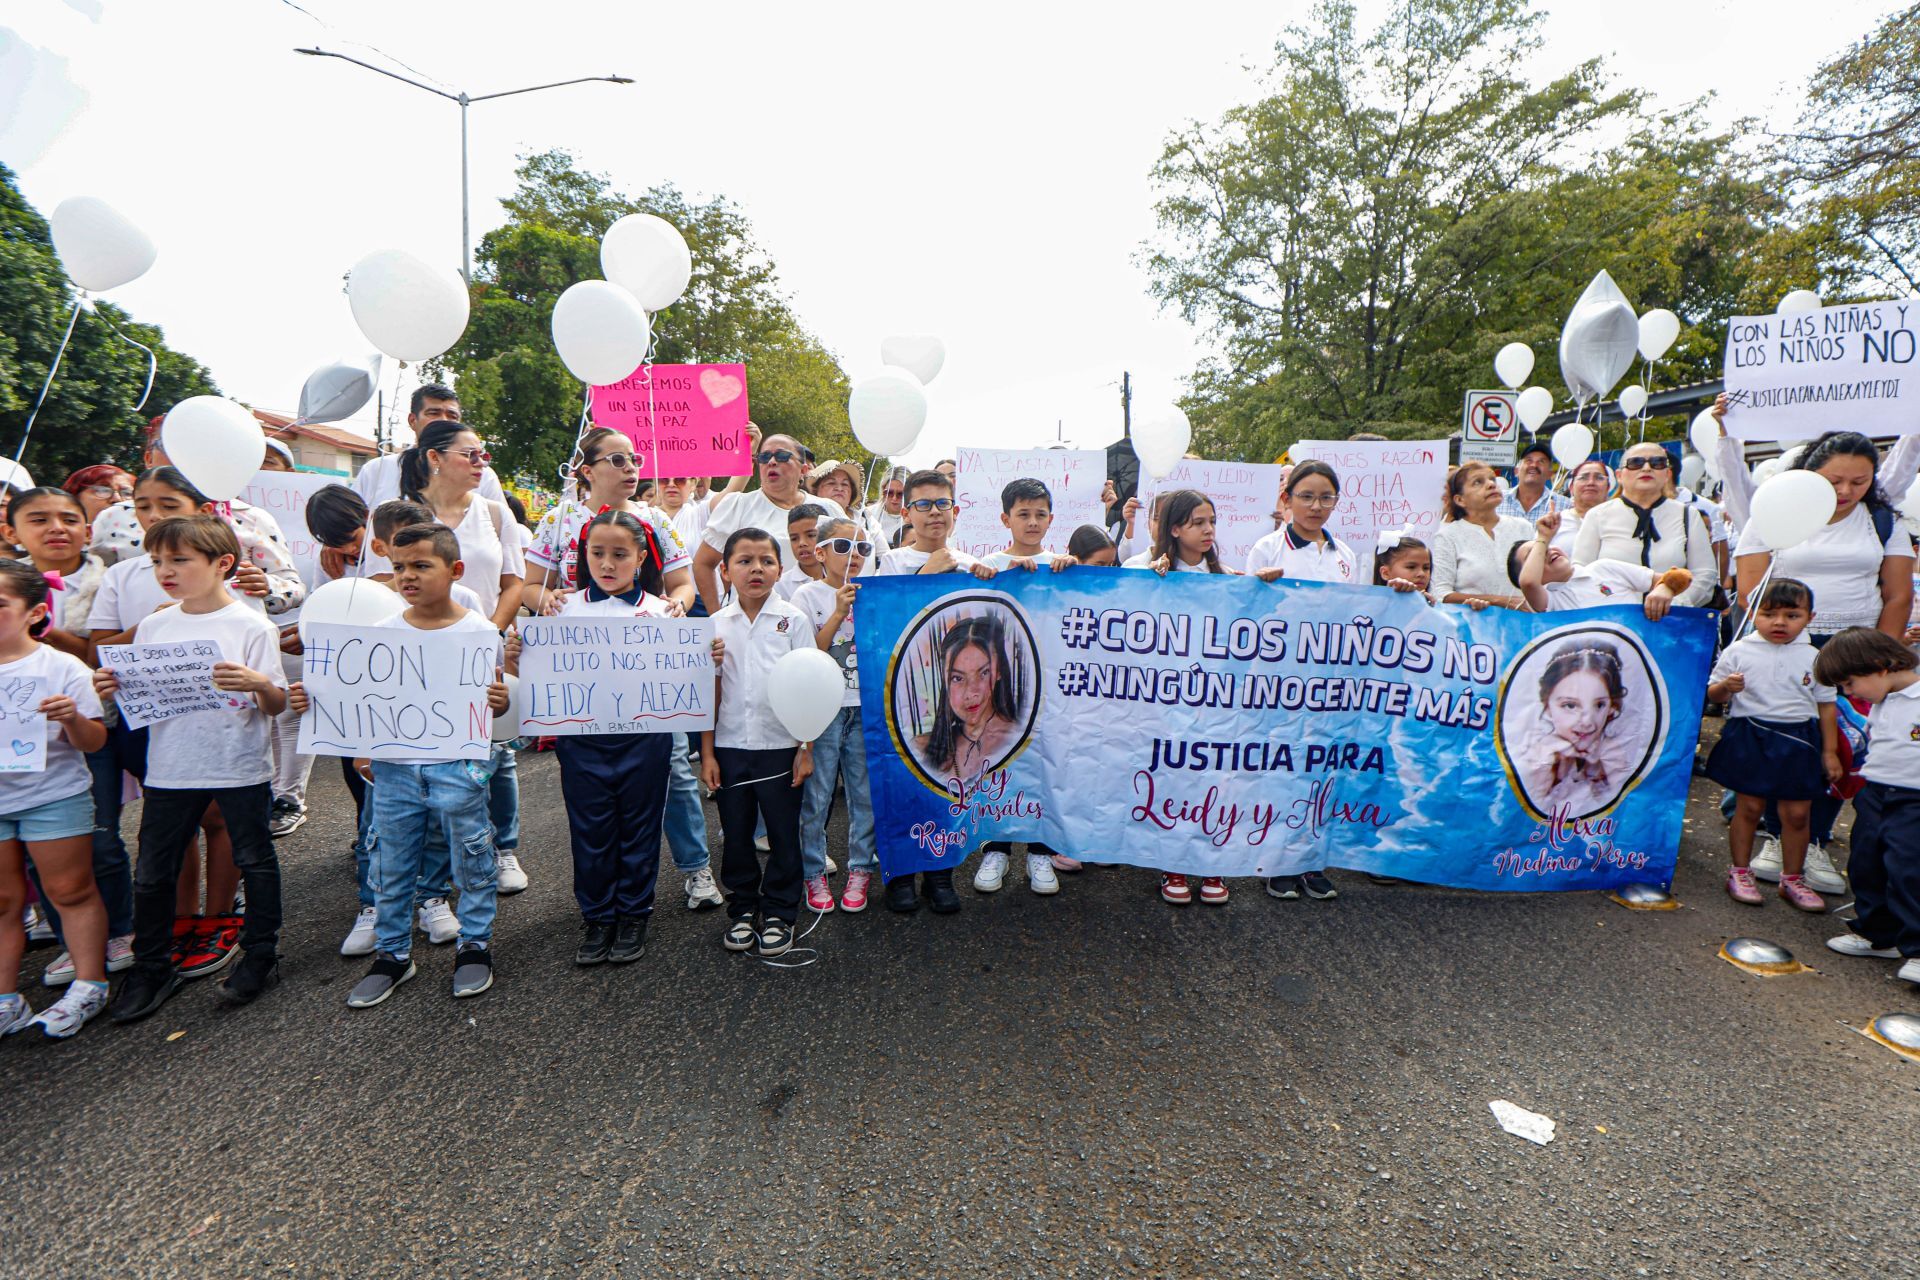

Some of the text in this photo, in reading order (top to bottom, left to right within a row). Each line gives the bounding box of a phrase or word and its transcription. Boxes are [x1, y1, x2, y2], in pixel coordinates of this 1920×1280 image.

[1732, 305, 1909, 344] CON LAS NIÑAS Y
[1735, 328, 1917, 368] LOS NIÑOS NO
[608, 400, 692, 413] UN SINALOA
[635, 415, 689, 428] EN PAZ
[659, 435, 698, 451] niños
[1216, 470, 1256, 485] LEIDY
[1341, 515, 1361, 526] DE
[1371, 499, 1412, 513] NADA
[523, 624, 703, 647] CULIACAN ESTA DE
[1061, 607, 1497, 686] #CON LOS NIÑOS NO
[103, 646, 140, 665] Feliz
[174, 644, 187, 658] el
[304, 637, 495, 691] #CON LOS
[552, 651, 708, 673] LUTO NOS FALTAN
[530, 681, 702, 718] LEIDY Y ALEXA
[1058, 662, 1493, 731] #NINGÚN INOCENTE MÁS
[312, 692, 455, 741] NIÑOS
[607, 721, 651, 733] BASTA!
[1148, 738, 1386, 775] JUSTICIA PARA
[1130, 770, 1245, 847] Leidy
[1252, 797, 1281, 847] y
[1529, 801, 1616, 850] Alexa
[909, 820, 968, 858] Rojas
[1492, 847, 1583, 878] Medina
